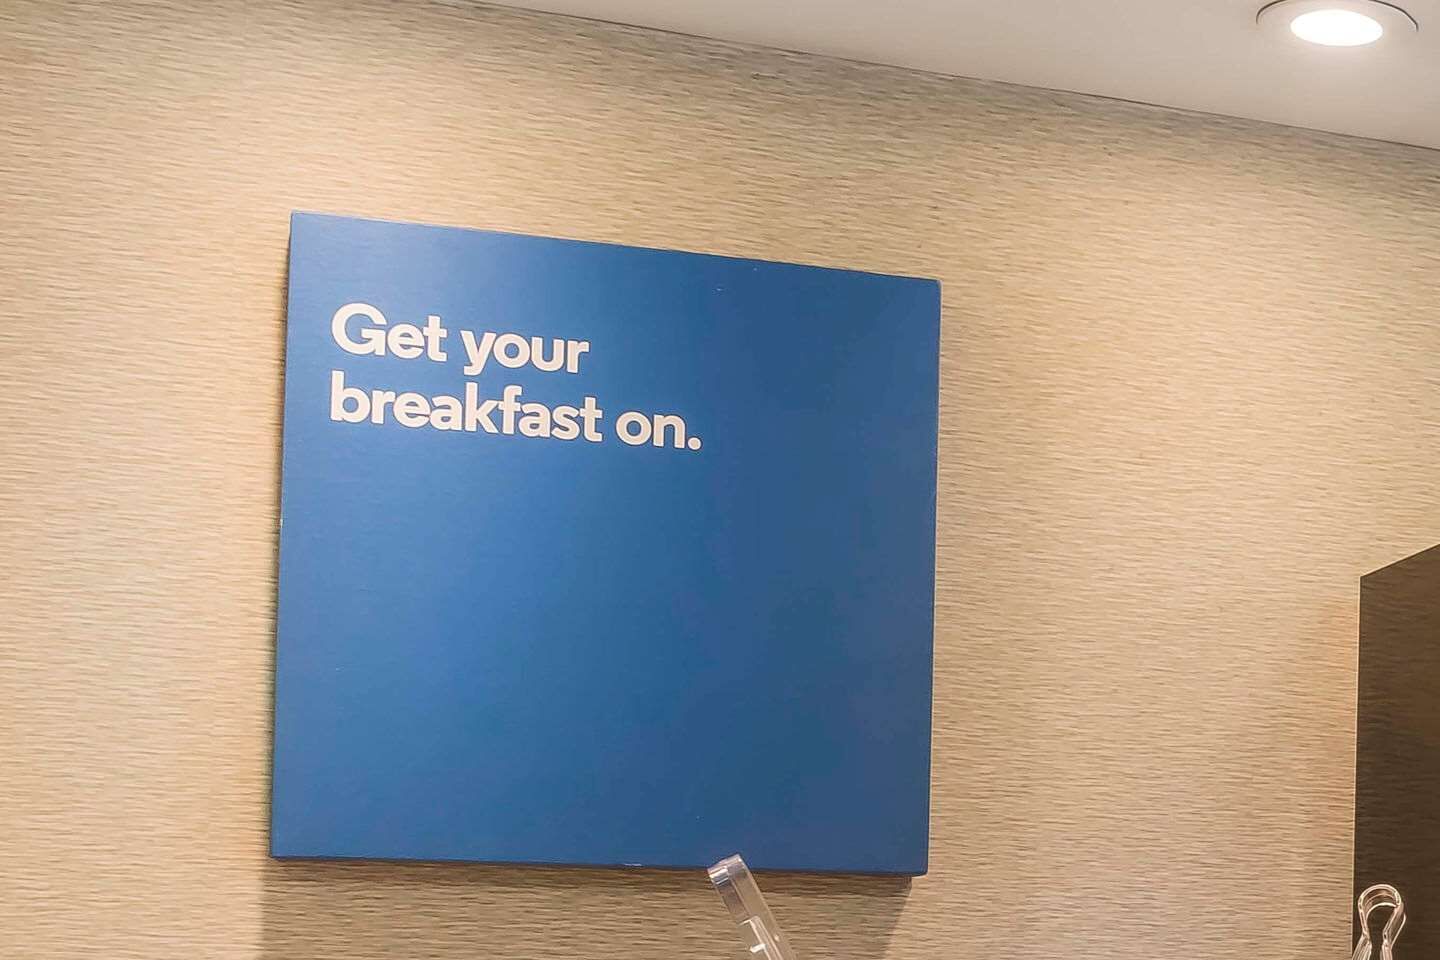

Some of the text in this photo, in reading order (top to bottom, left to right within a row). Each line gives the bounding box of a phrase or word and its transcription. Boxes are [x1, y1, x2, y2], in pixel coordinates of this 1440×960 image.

[331, 302, 590, 376] Get your
[330, 370, 703, 451] breakfast on.
